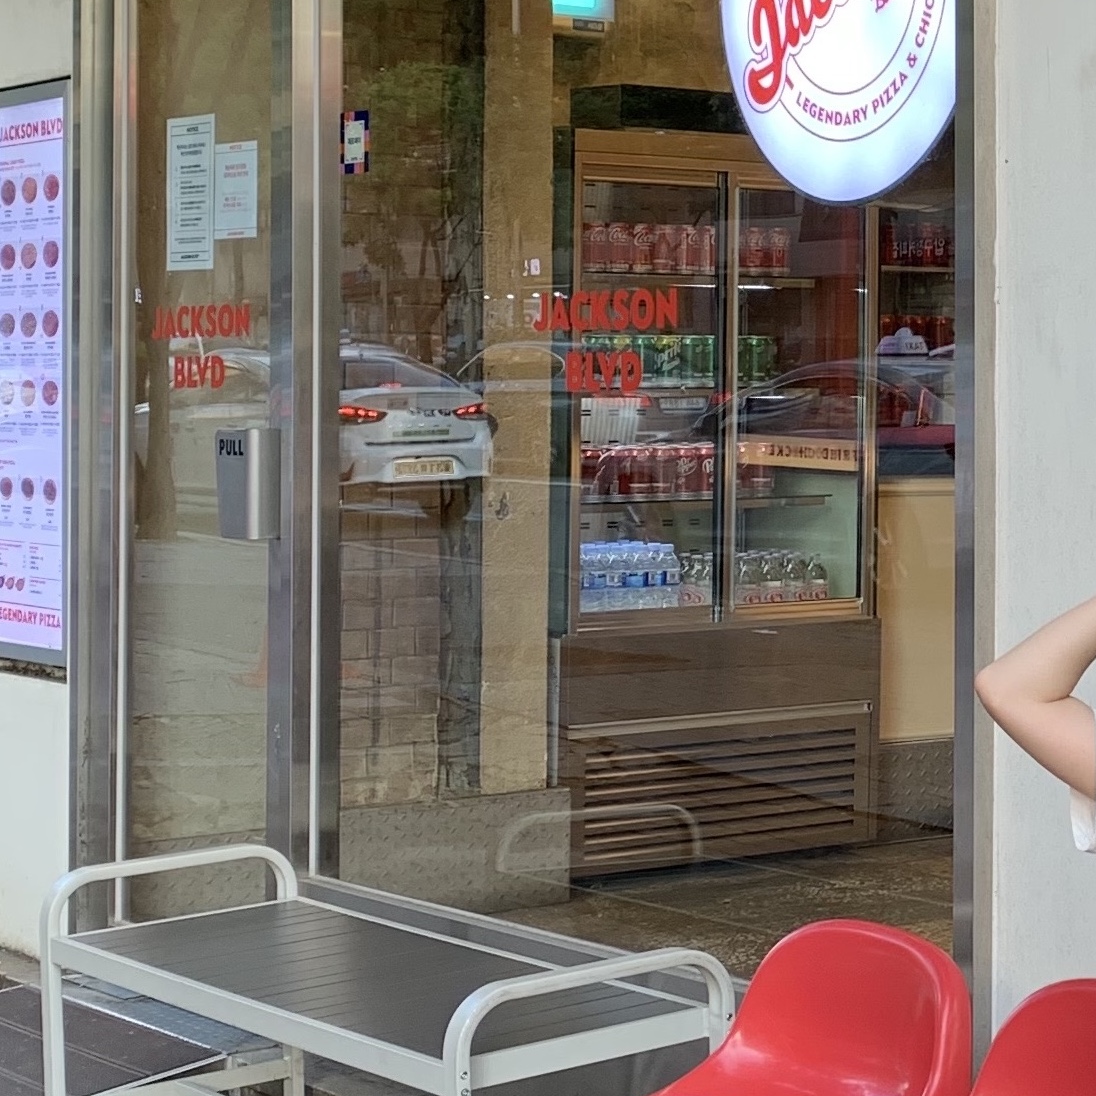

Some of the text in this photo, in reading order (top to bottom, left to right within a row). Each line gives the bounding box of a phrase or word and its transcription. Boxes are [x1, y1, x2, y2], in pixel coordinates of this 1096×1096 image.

[796, 92, 868, 126] LEGENDARY
[872, 71, 908, 114] PIZZA
[906, 51, 918, 68] &
[41, 118, 63, 136] BLVD
[152, 303, 250, 340] JACKSON
[532, 287, 680, 332] JACKSON
[174, 354, 226, 390] BLVD
[566, 350, 644, 394] BLVD
[219, 438, 244, 456] PULL
[39, 612, 61, 628] PIZZA
